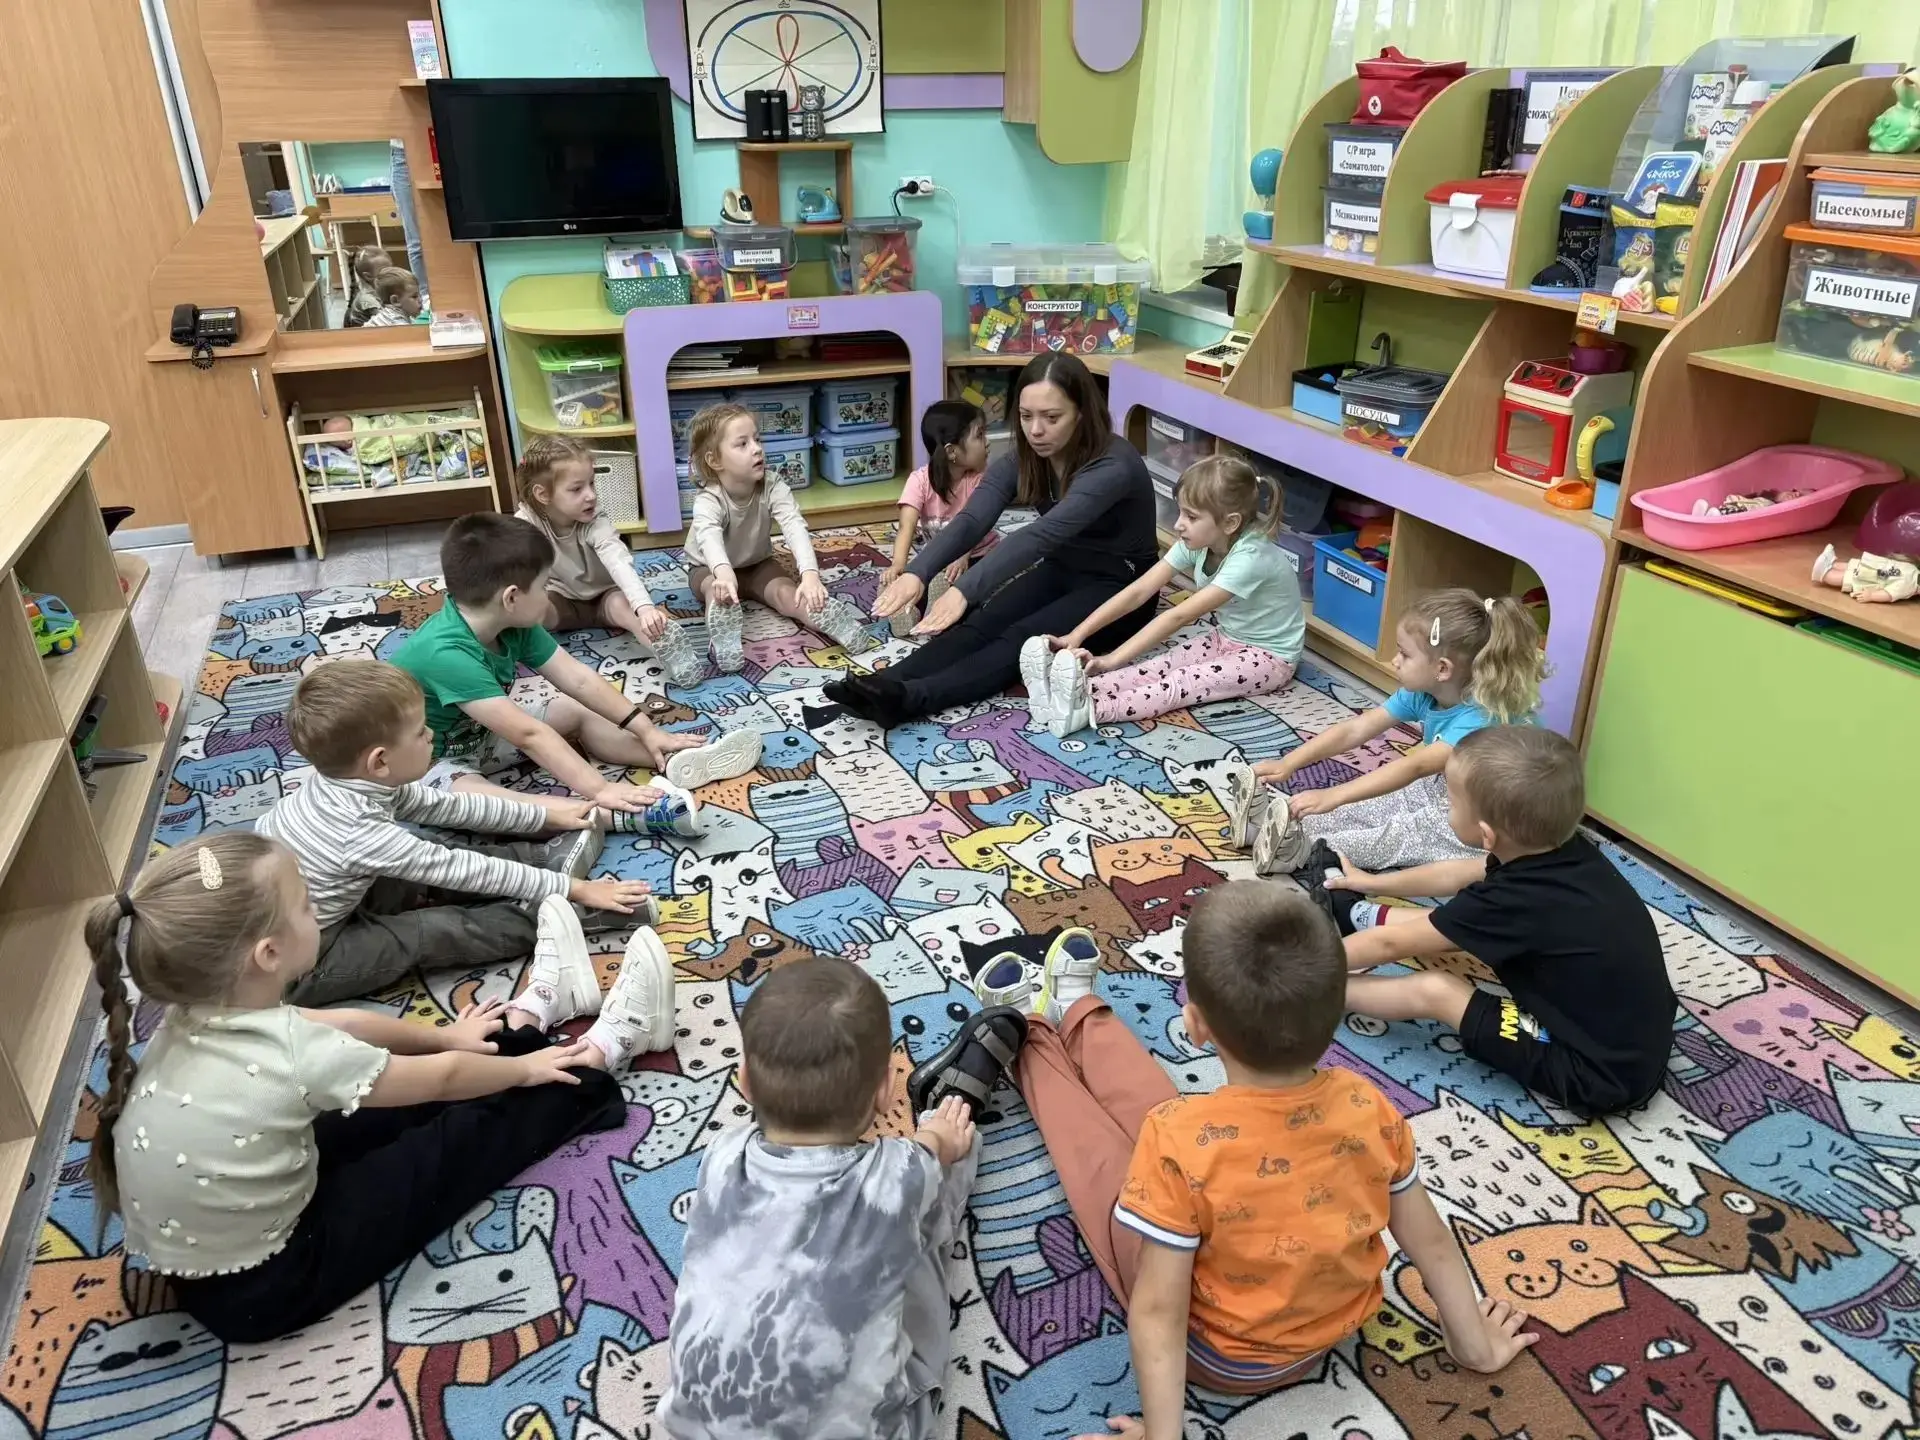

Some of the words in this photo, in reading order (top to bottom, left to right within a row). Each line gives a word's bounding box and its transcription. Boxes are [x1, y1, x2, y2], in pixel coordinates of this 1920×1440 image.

[1559, 86, 1585, 99] Цент
[1525, 109, 1554, 120] сюже
[1359, 147, 1376, 158] игра
[1335, 208, 1378, 223] Медикаменты
[1817, 201, 1905, 220] Насекомые
[1813, 275, 1911, 305] Животные
[1027, 302, 1080, 310] КОНСТРУКТОР
[1349, 405, 1390, 423] ПОСУДА
[1336, 567, 1361, 586] ОВОЩИ
